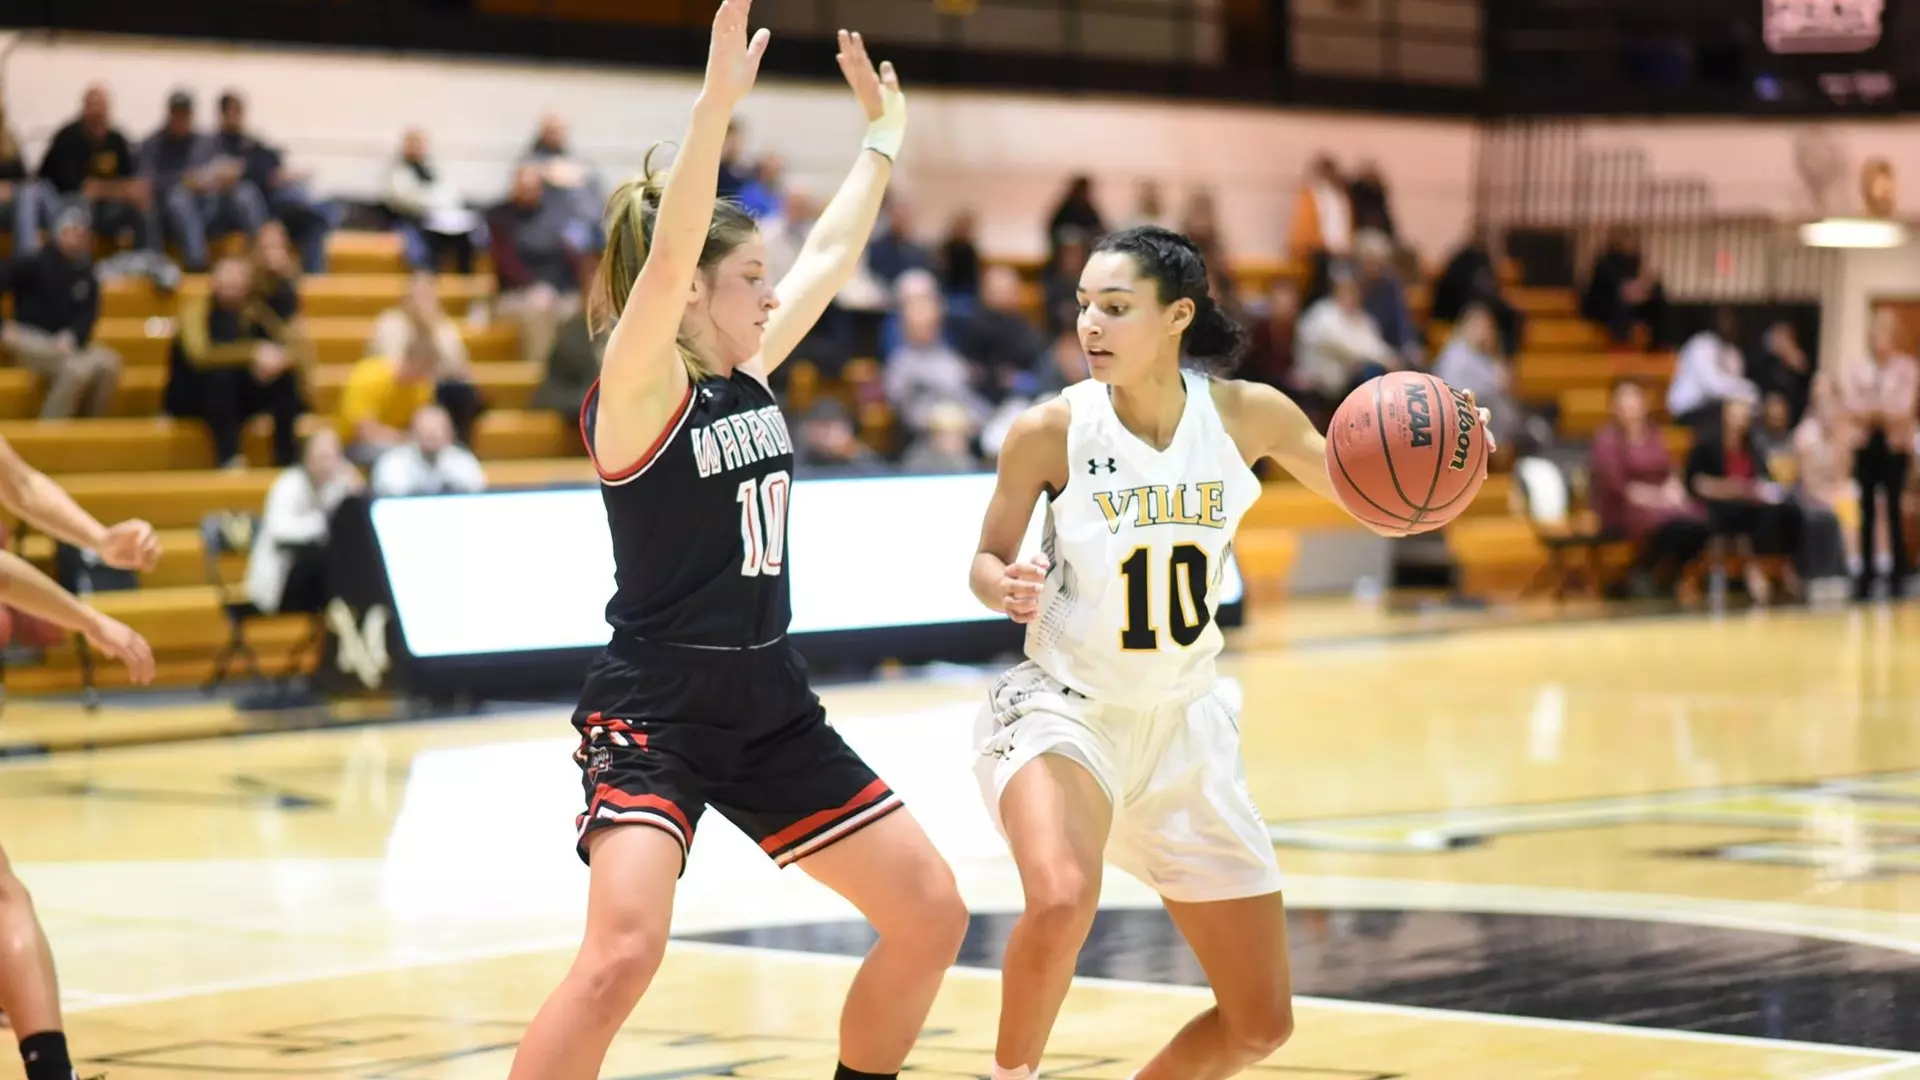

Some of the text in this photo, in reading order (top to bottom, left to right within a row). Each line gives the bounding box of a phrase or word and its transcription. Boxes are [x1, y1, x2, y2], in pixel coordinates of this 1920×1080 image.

[1404, 382, 1432, 448] NCAA
[736, 470, 790, 577] 10
[1119, 541, 1213, 652] 10
